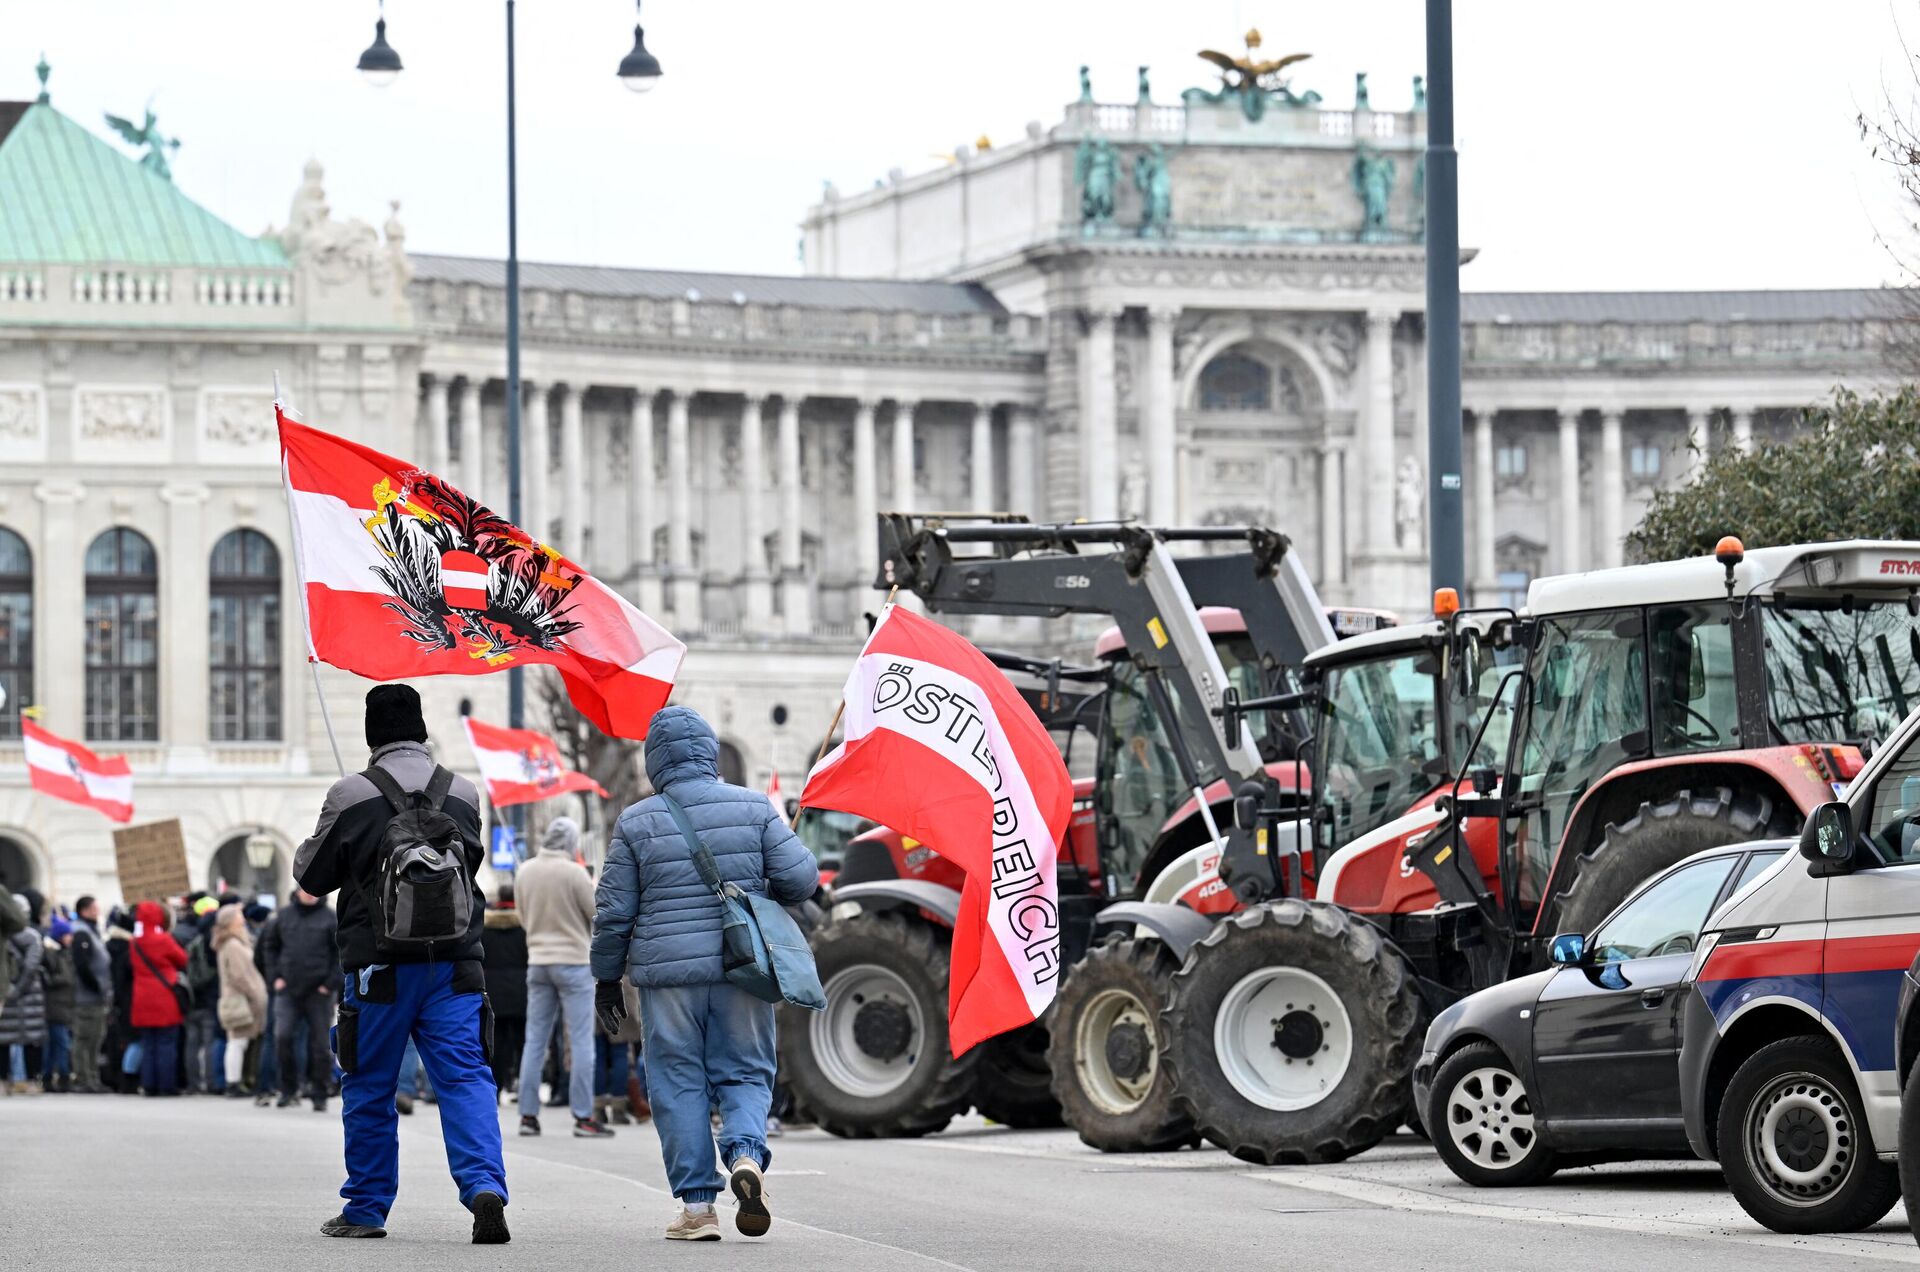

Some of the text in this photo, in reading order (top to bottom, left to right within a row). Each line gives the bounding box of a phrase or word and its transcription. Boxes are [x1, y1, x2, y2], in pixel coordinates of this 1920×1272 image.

[1880, 560, 1920, 575] STEYR
[872, 662, 1061, 985] ÖSTEREICH
[1202, 854, 1220, 873] ST
